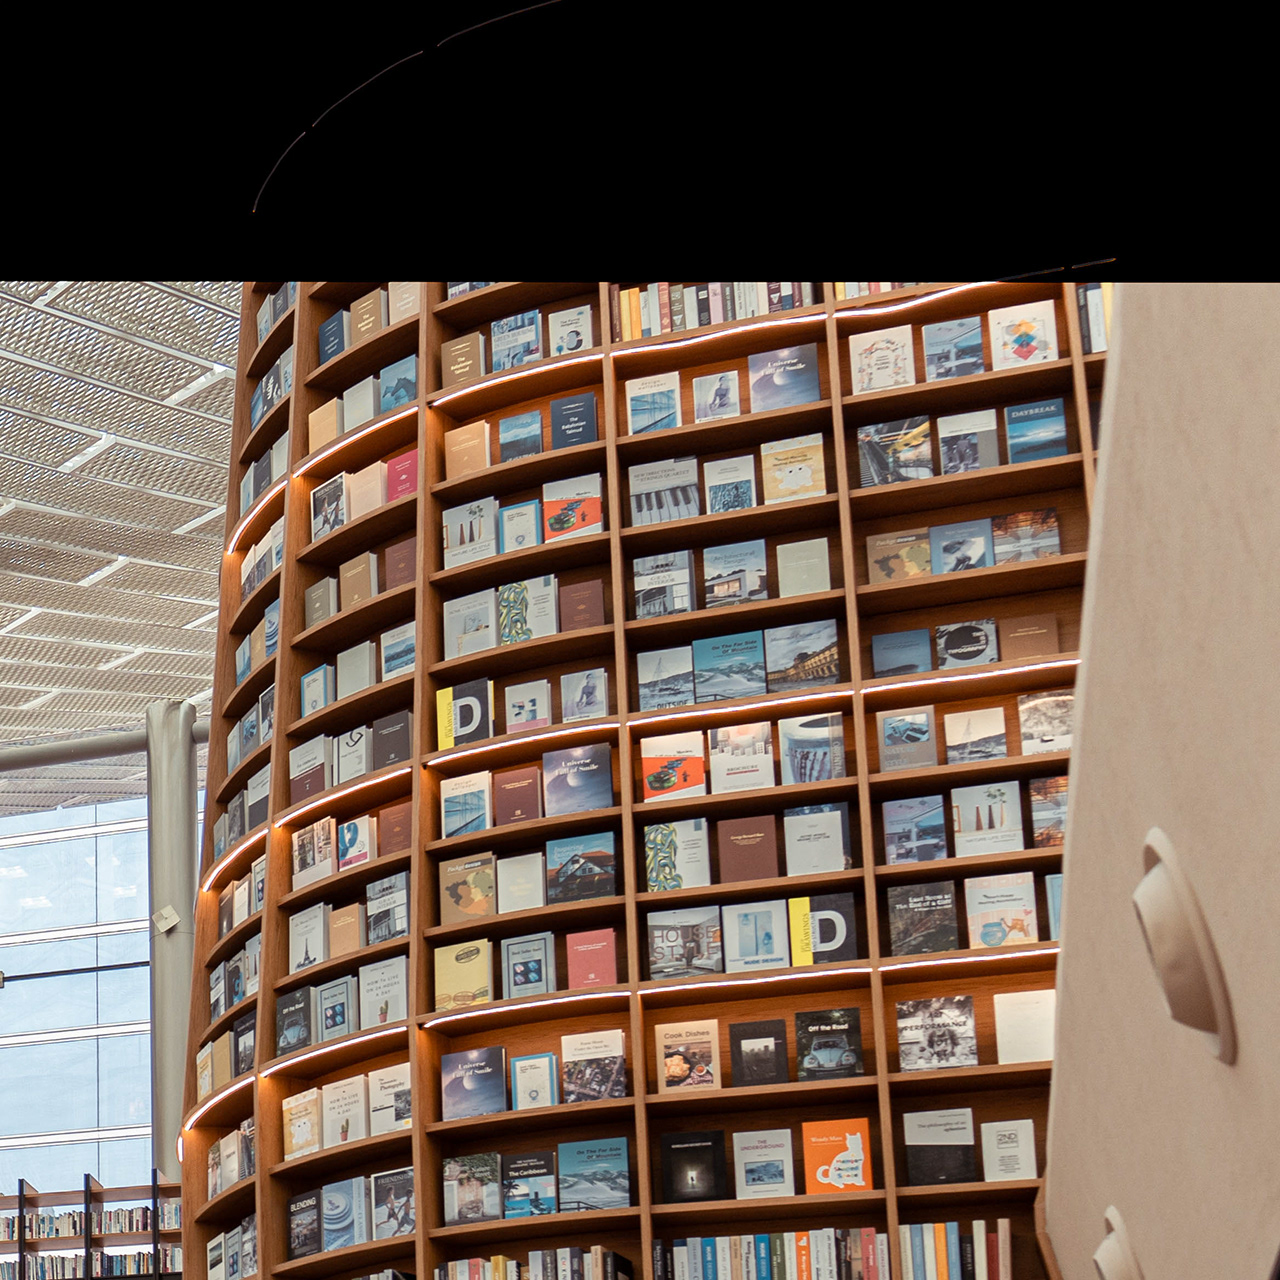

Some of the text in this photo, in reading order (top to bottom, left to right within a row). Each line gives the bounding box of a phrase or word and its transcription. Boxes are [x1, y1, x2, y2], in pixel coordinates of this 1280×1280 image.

[1011, 405, 1057, 418] DAYBREAK
[664, 1029, 710, 1041] Cook Dishes
